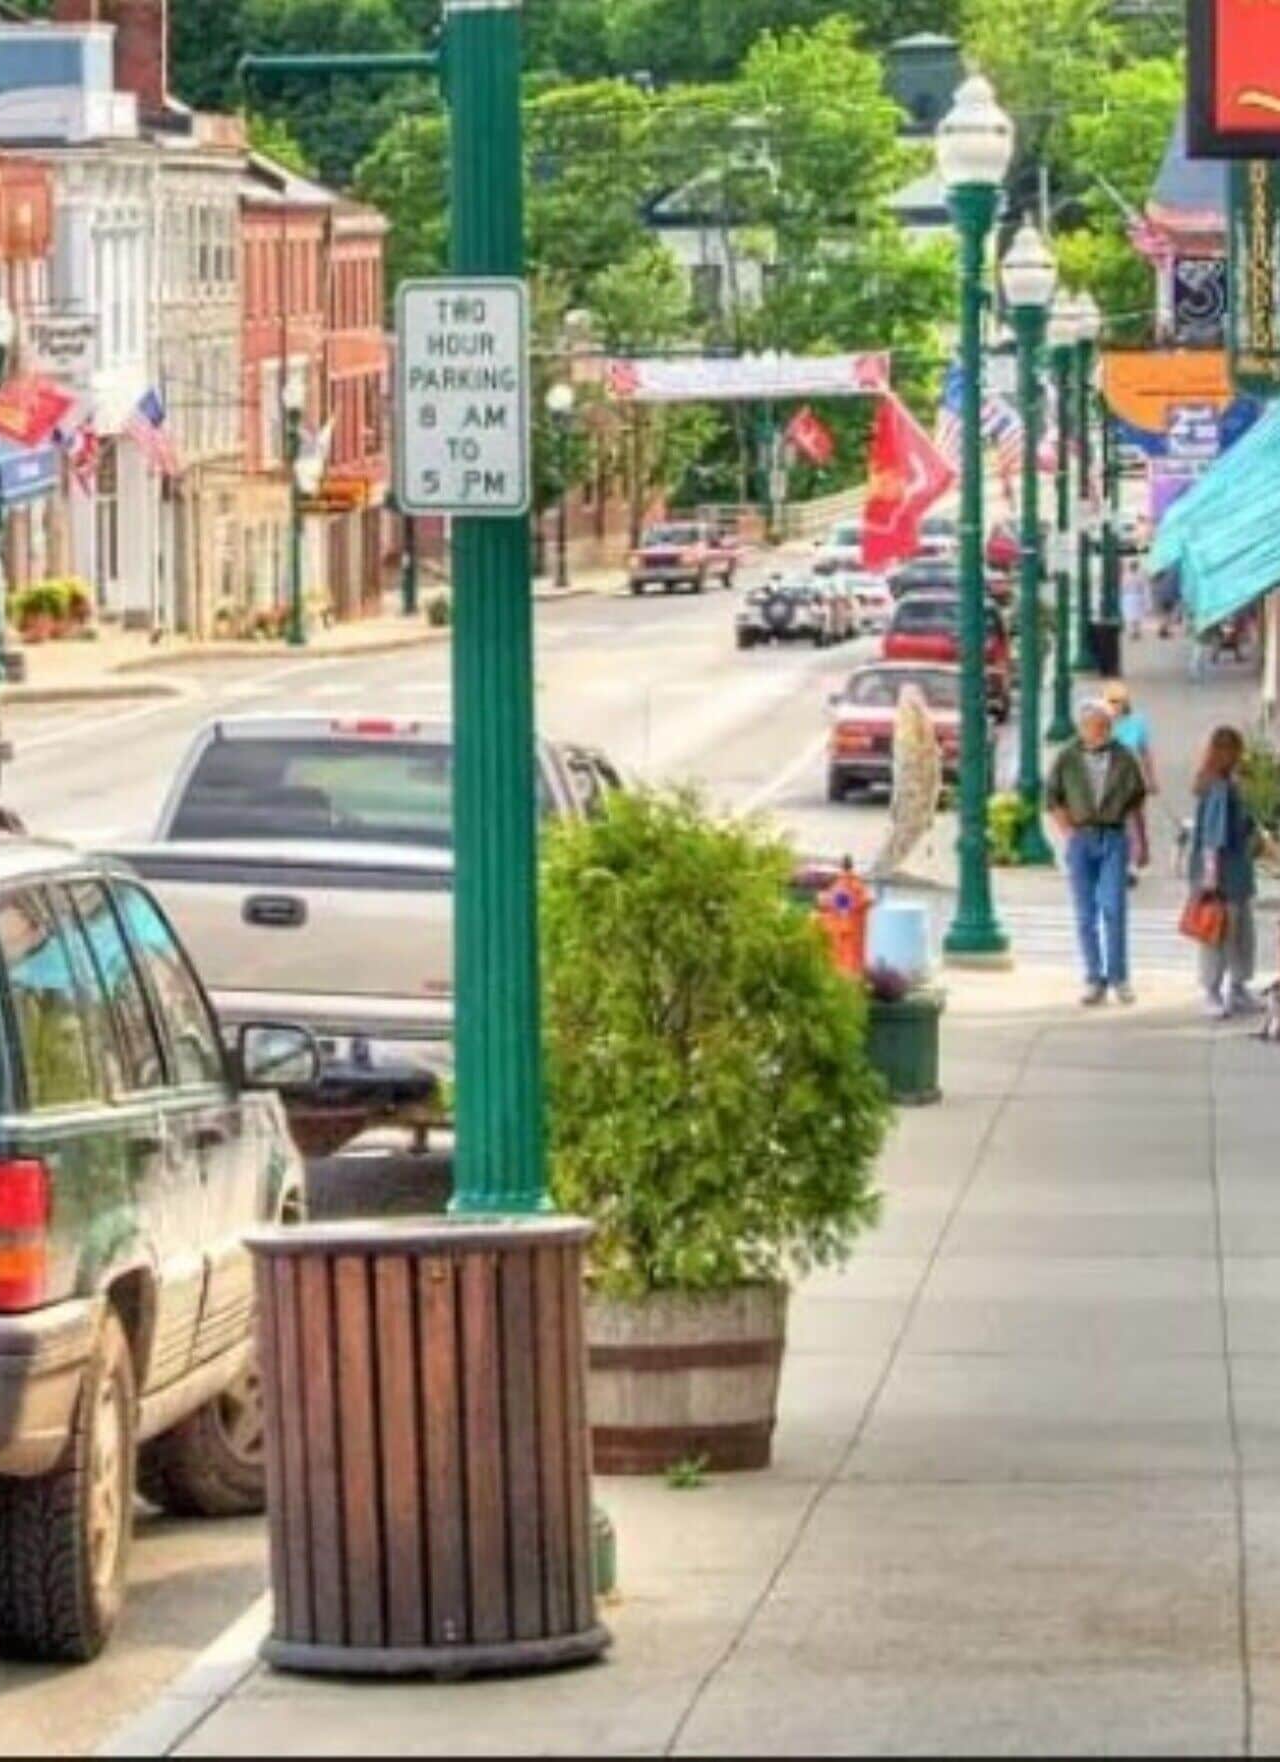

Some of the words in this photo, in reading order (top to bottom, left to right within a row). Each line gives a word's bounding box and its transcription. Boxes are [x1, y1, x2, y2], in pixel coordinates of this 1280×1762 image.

[436, 299, 486, 325] TWO
[427, 333, 494, 356] HOUR
[409, 367, 516, 391] PARKING
[419, 404, 437, 428] 8
[462, 404, 506, 429] AM
[446, 437, 480, 461] TO
[423, 470, 440, 494] 5
[462, 471, 506, 495] PM
